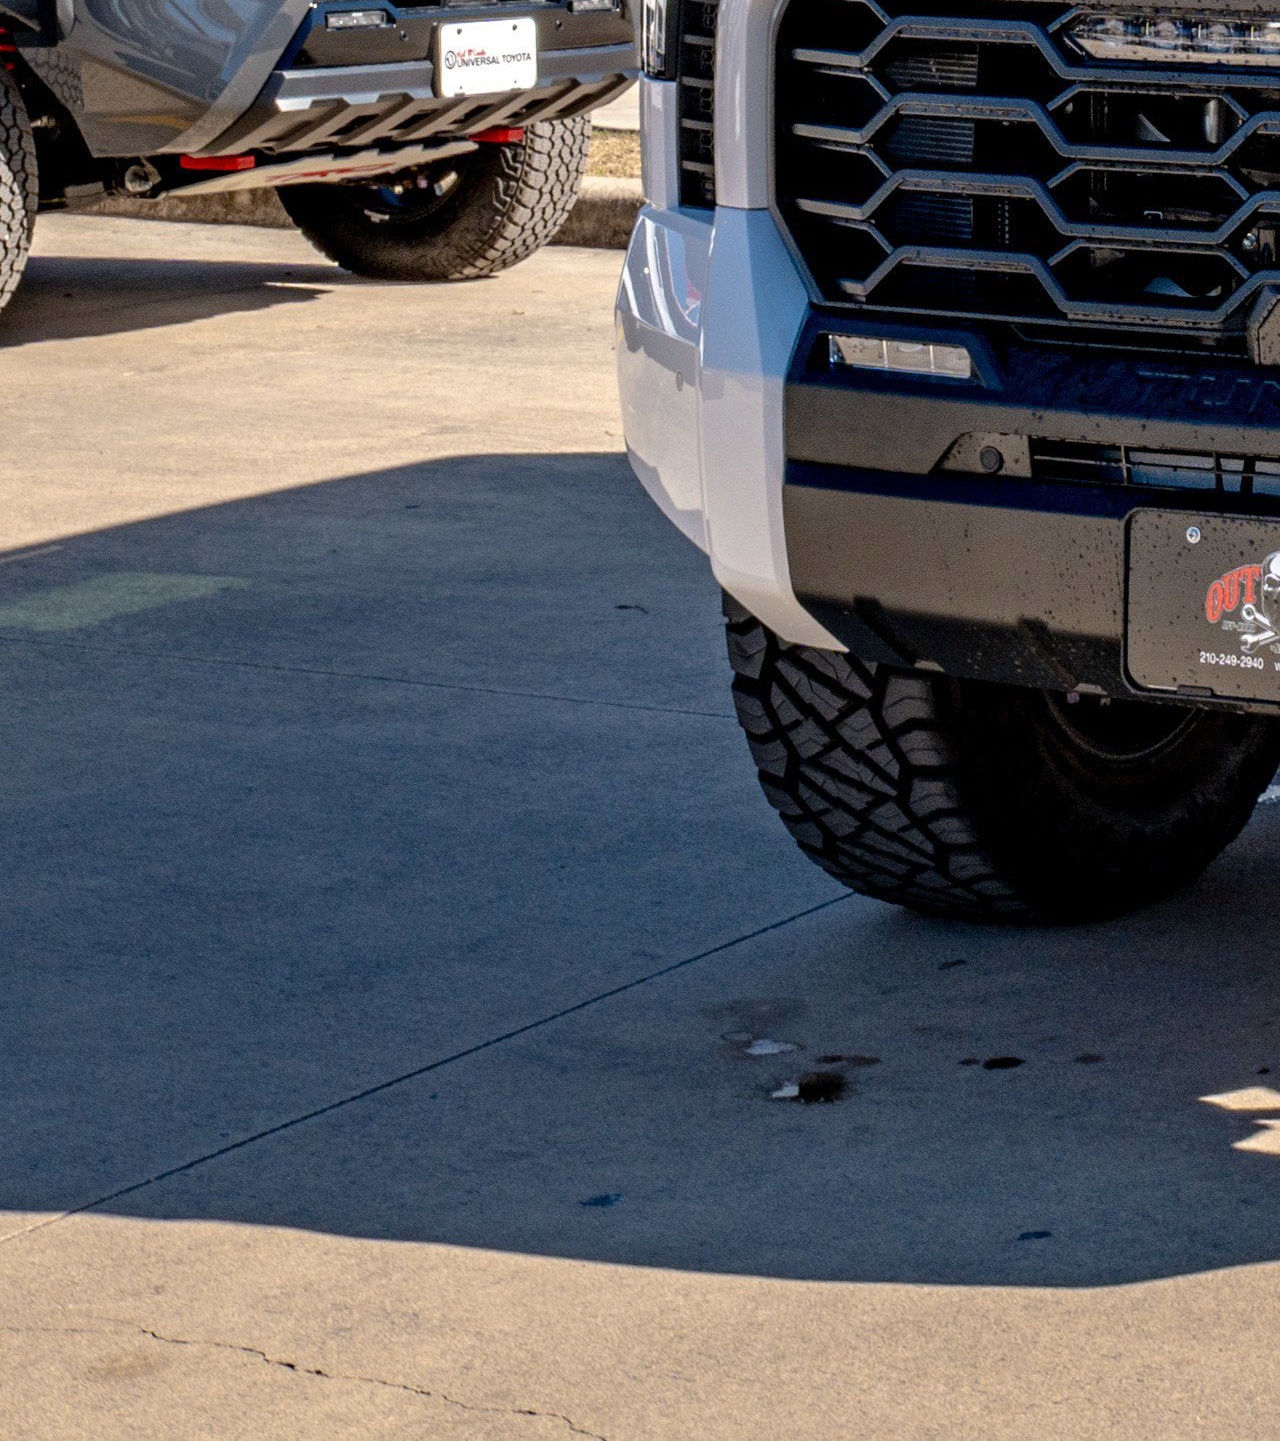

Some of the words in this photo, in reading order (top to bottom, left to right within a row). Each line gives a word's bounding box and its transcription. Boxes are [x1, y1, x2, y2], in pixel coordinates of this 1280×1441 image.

[456, 55, 500, 68] UNIVERSAL
[502, 52, 532, 63] TOYOTA
[1199, 651, 1265, 671] 210-249-2940
